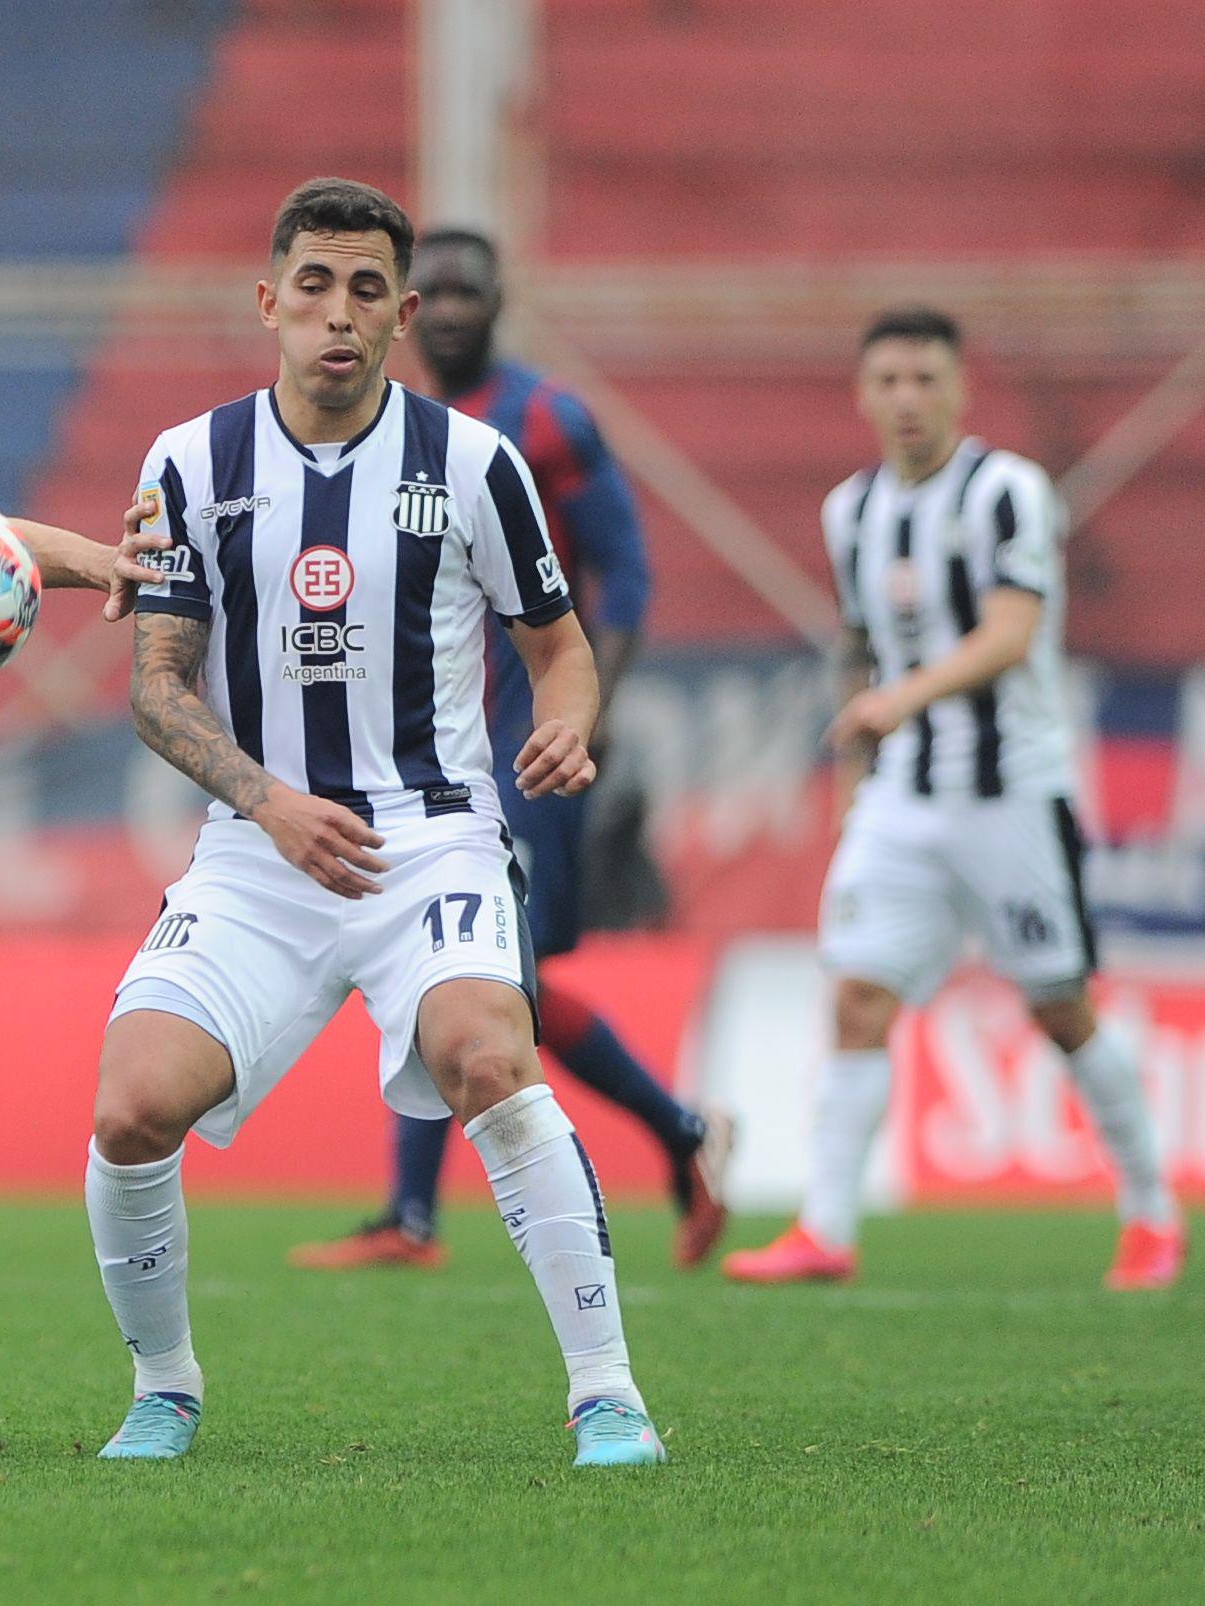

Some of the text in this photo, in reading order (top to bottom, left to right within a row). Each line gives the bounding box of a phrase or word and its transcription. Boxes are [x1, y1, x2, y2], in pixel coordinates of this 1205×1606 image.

[281, 623, 365, 652] ICBC
[282, 663, 367, 681] Argentina
[422, 892, 482, 953] 17
